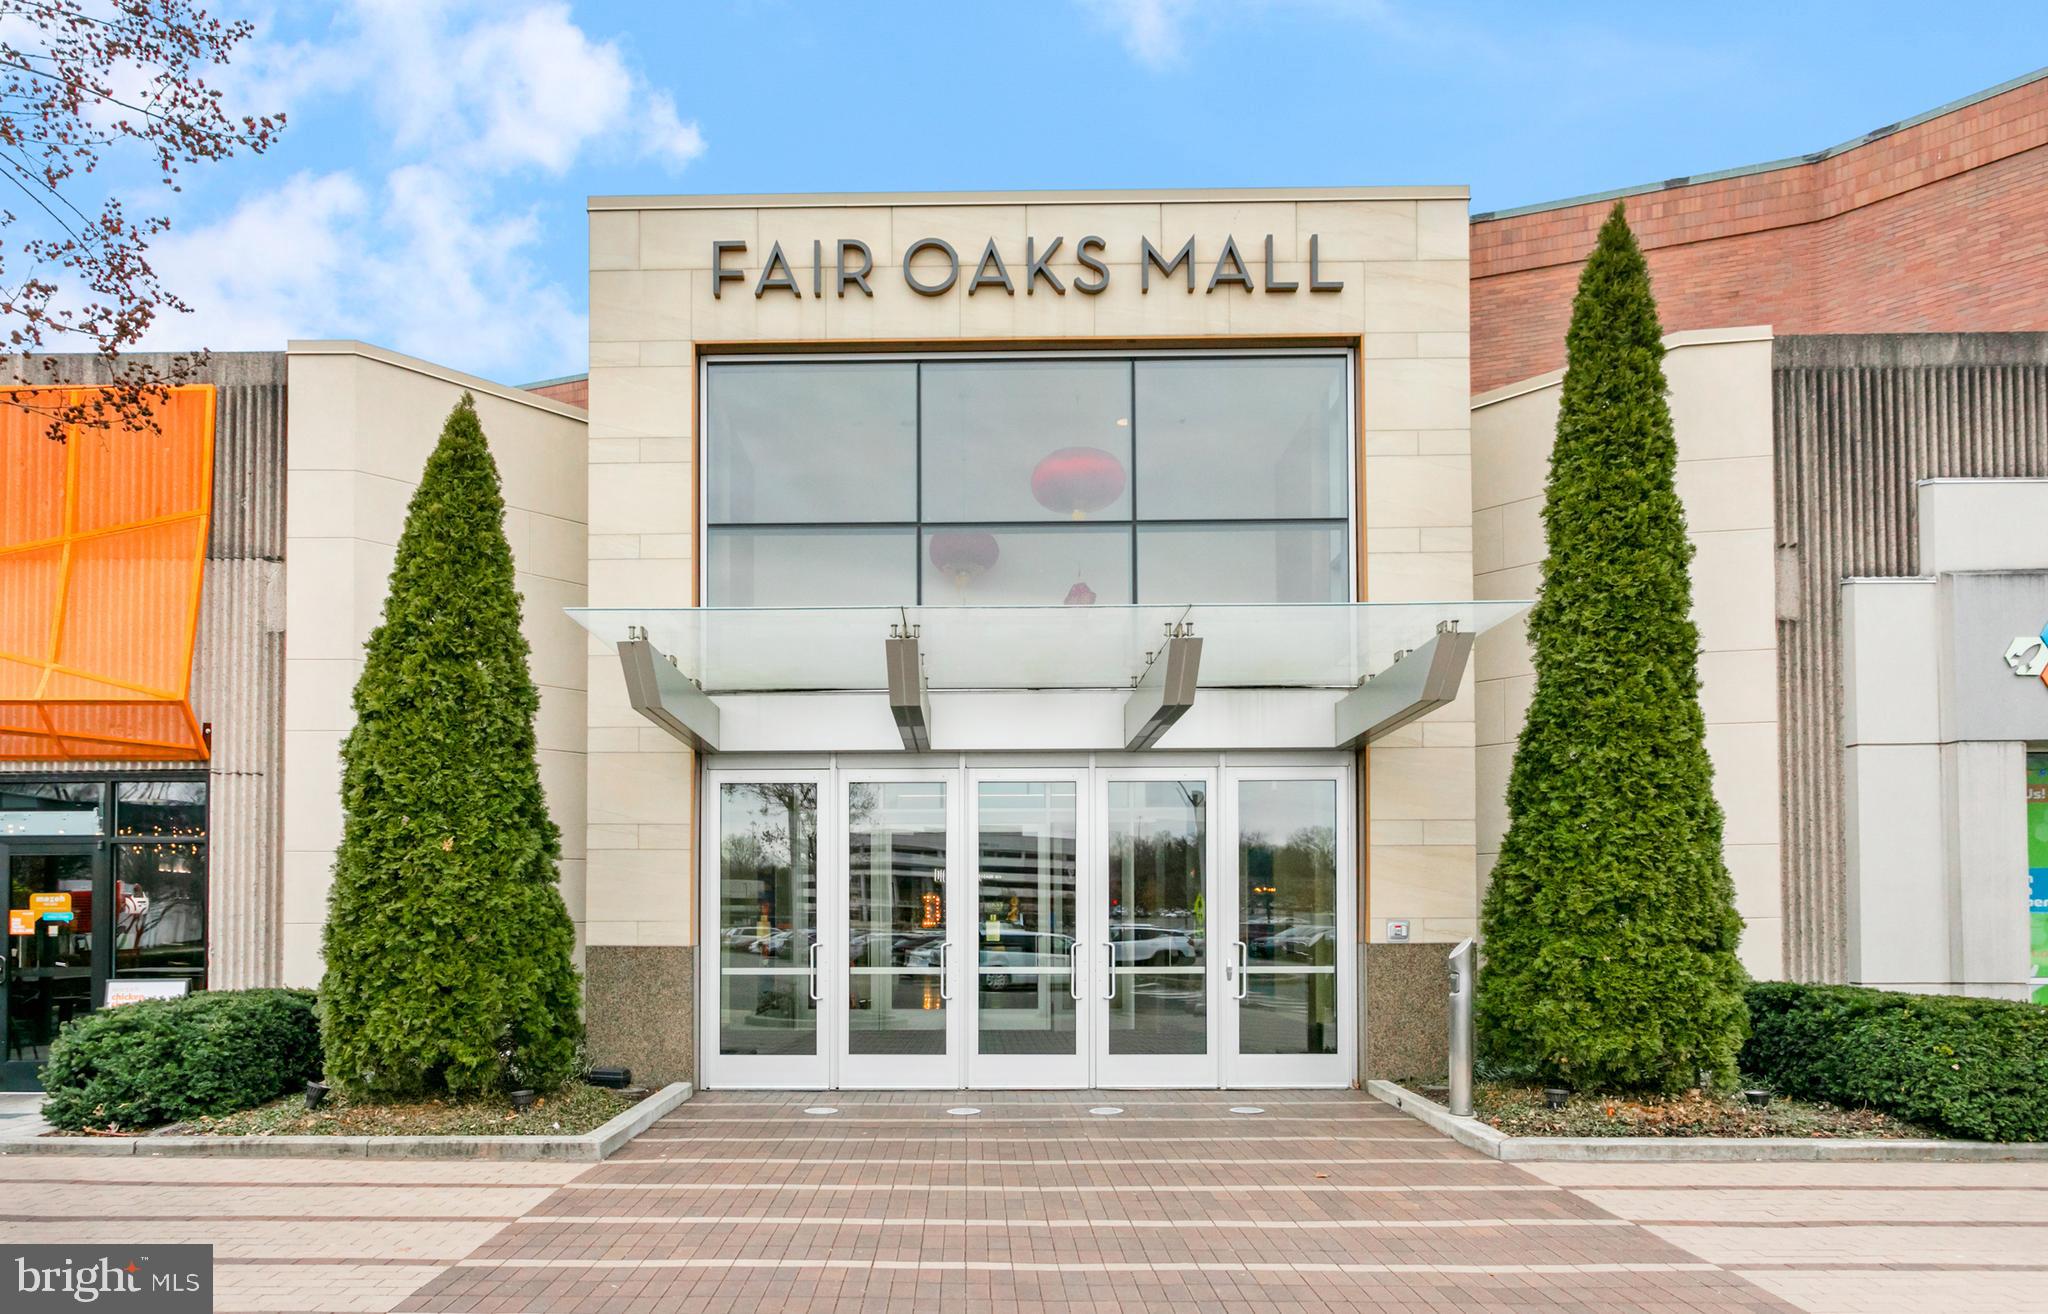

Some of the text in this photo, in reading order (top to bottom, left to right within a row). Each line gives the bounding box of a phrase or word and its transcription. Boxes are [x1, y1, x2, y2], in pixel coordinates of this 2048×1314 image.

[712, 234, 1345, 301] FAIR OAKS MALL
